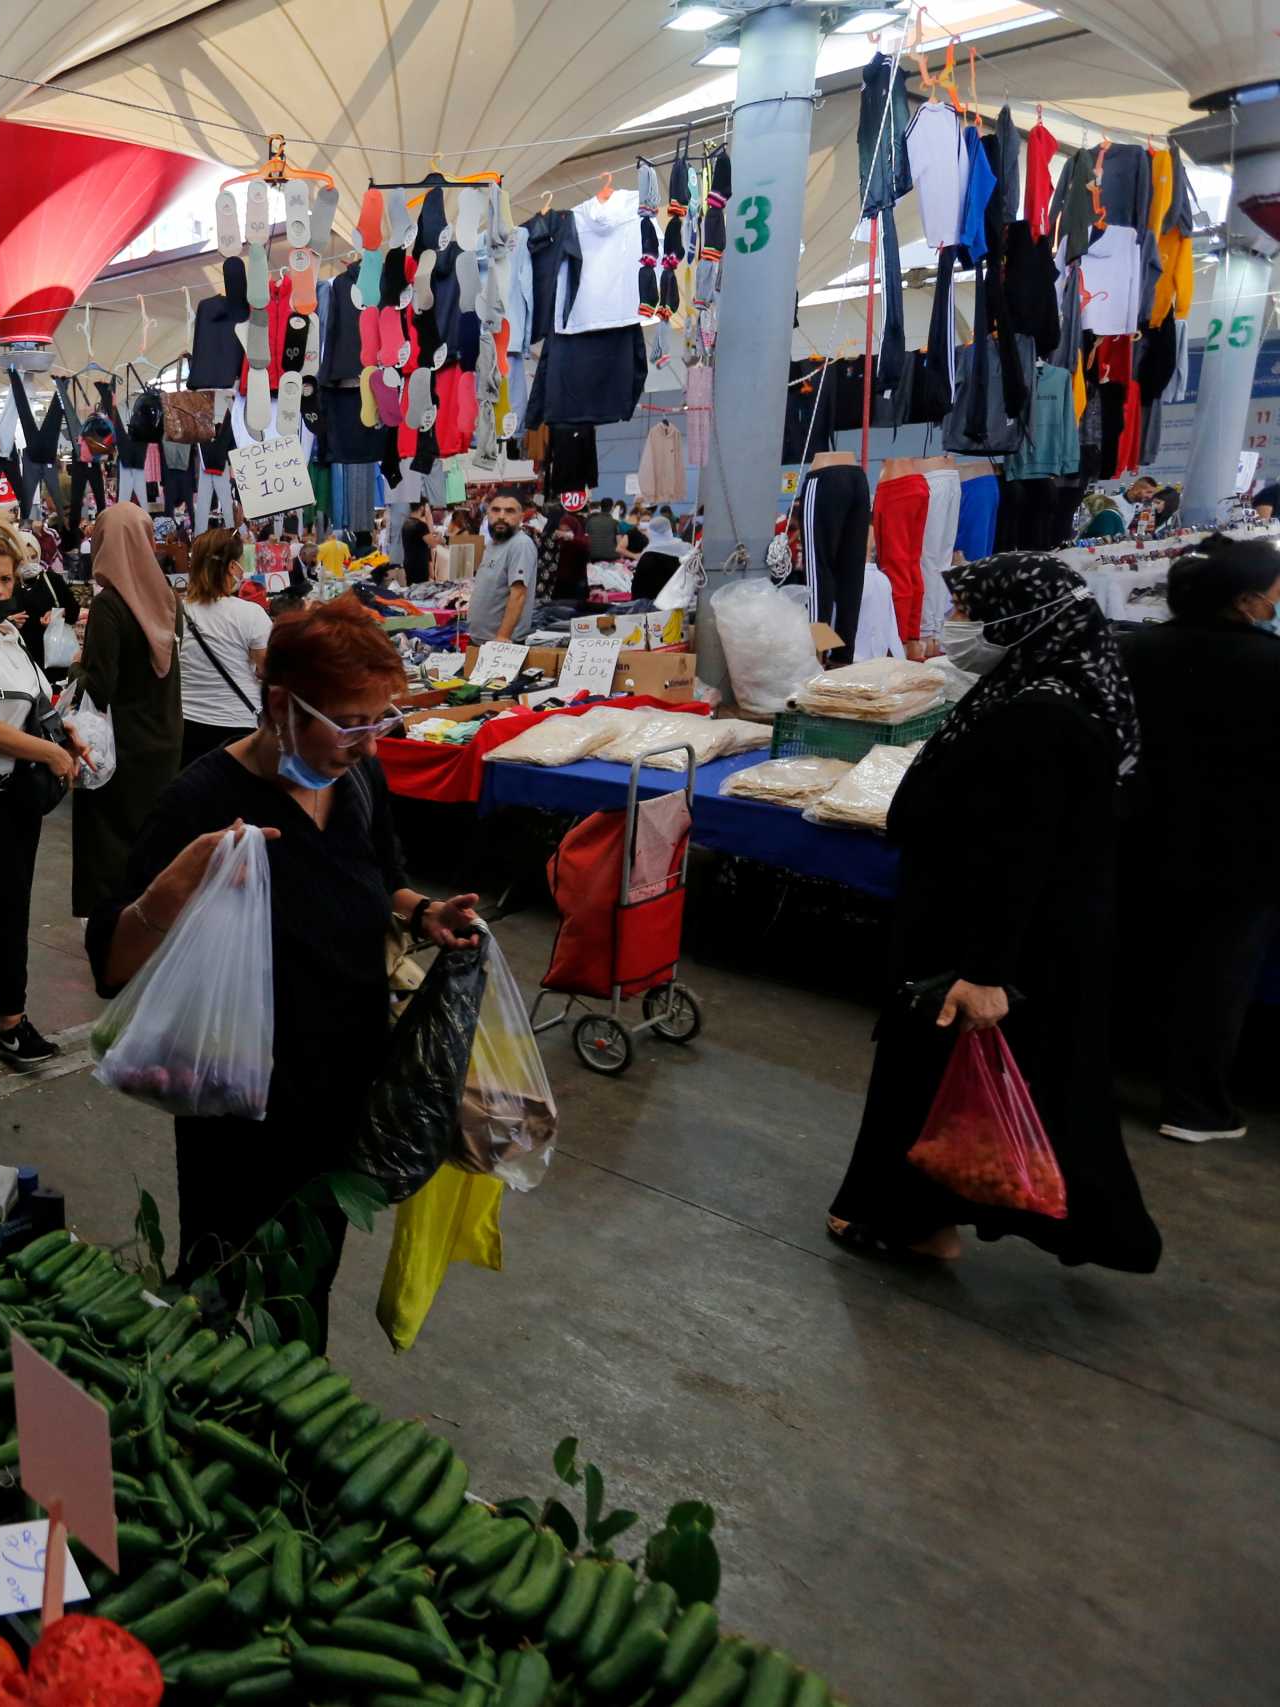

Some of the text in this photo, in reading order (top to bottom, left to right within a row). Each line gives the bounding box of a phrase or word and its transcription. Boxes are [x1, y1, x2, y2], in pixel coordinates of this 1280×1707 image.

[735, 195, 771, 254] 3
[1206, 315, 1256, 351] 25
[1256, 410, 1271, 423] 11
[1249, 435, 1267, 448] 12
[254, 459, 268, 477] 5
[260, 477, 285, 497] 10
[490, 655, 502, 668] 5
